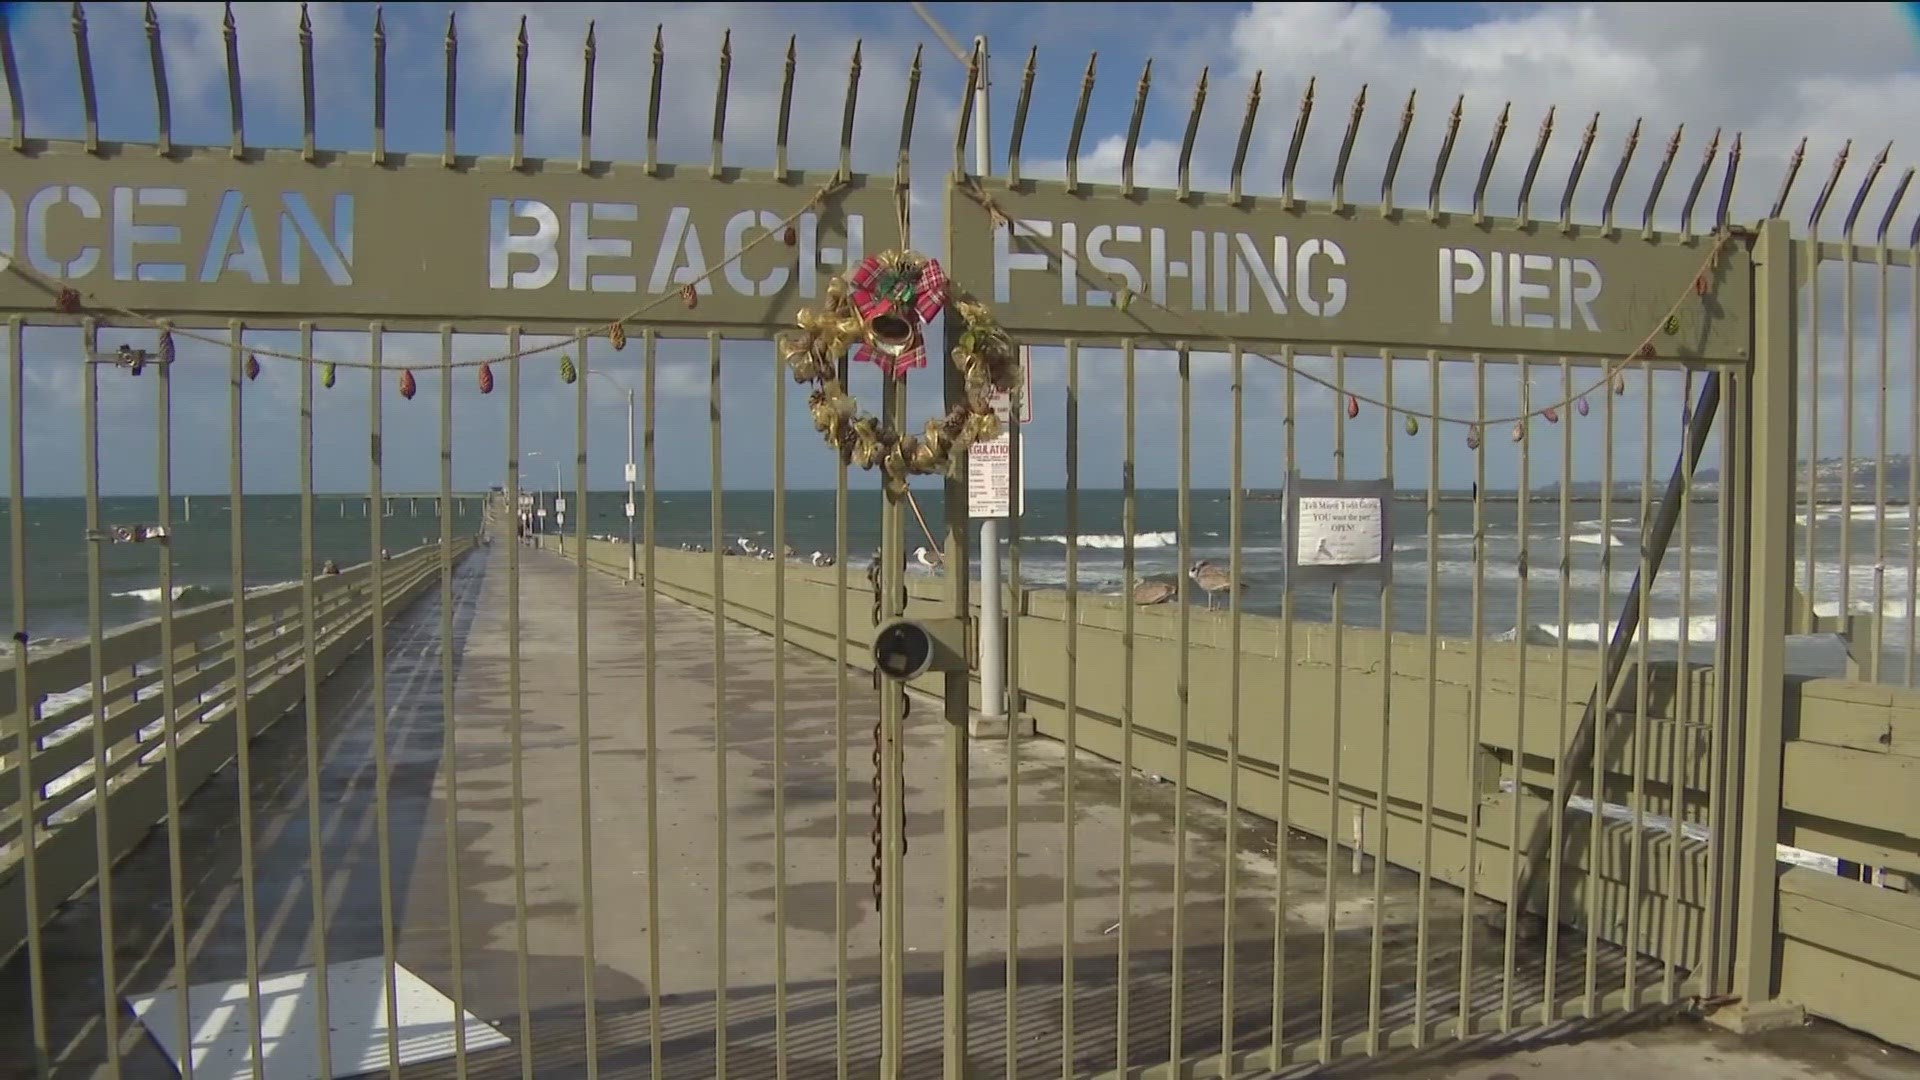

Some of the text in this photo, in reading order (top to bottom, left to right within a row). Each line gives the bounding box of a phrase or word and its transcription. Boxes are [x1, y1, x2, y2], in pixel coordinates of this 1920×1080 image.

[0, 185, 1601, 332] CEAN BEACH FISHING PIER
[1313, 513, 1331, 521] YOU
